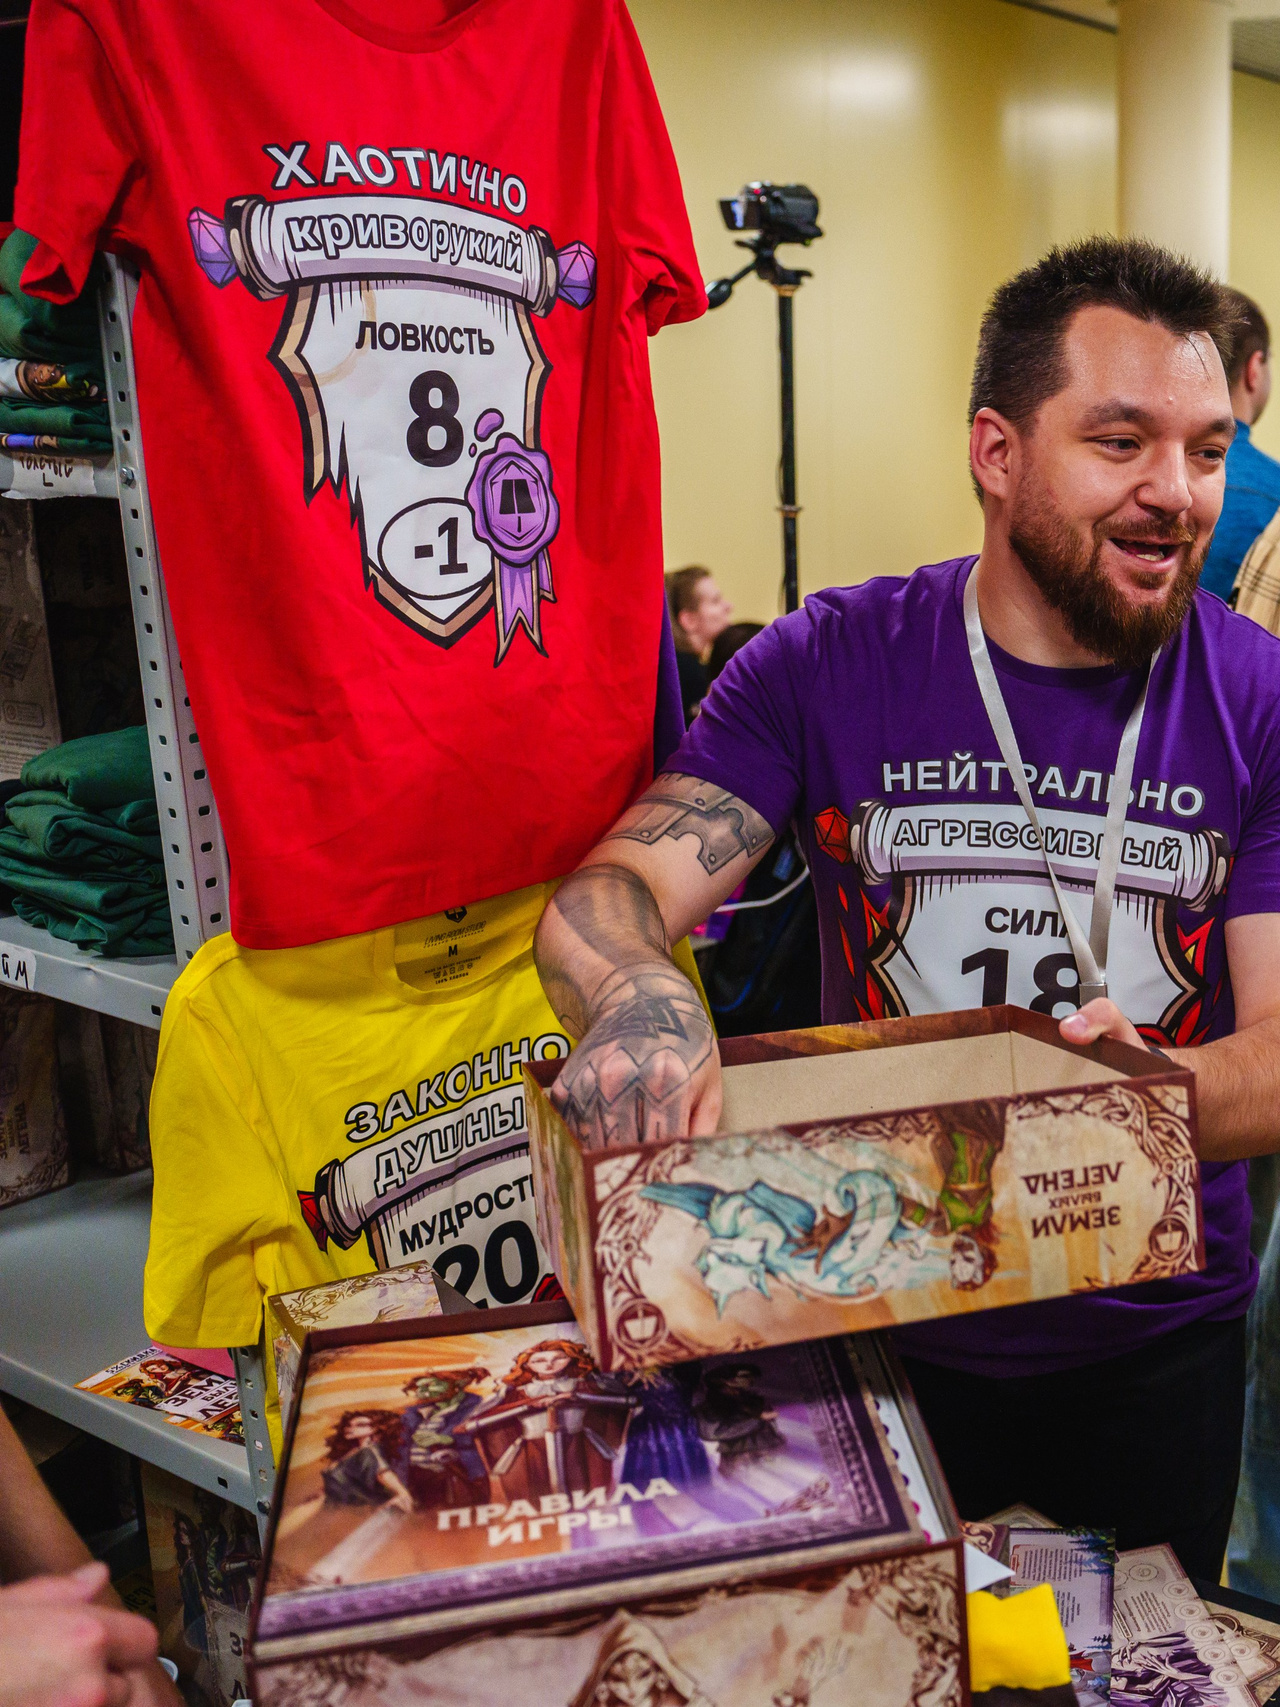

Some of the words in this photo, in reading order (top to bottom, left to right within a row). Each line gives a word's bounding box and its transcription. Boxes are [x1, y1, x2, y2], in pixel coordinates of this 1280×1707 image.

[262, 141, 527, 215] ХАОТИЧНО
[286, 214, 522, 273] криворукий
[355, 320, 495, 355] ЛОВКОСТЬ
[406, 369, 464, 468] 8
[414, 517, 468, 575] -1
[344, 1033, 571, 1142] ЗАКОННО
[374, 1096, 528, 1198] ДУШНЫ
[1020, 1160, 1125, 1195] ЛЕГЕНД
[1031, 1206, 1121, 1239] ЗЕМЛИ
[437, 1477, 679, 1531] ПРАВИЛА
[488, 1504, 633, 1547] ИГРЫ
